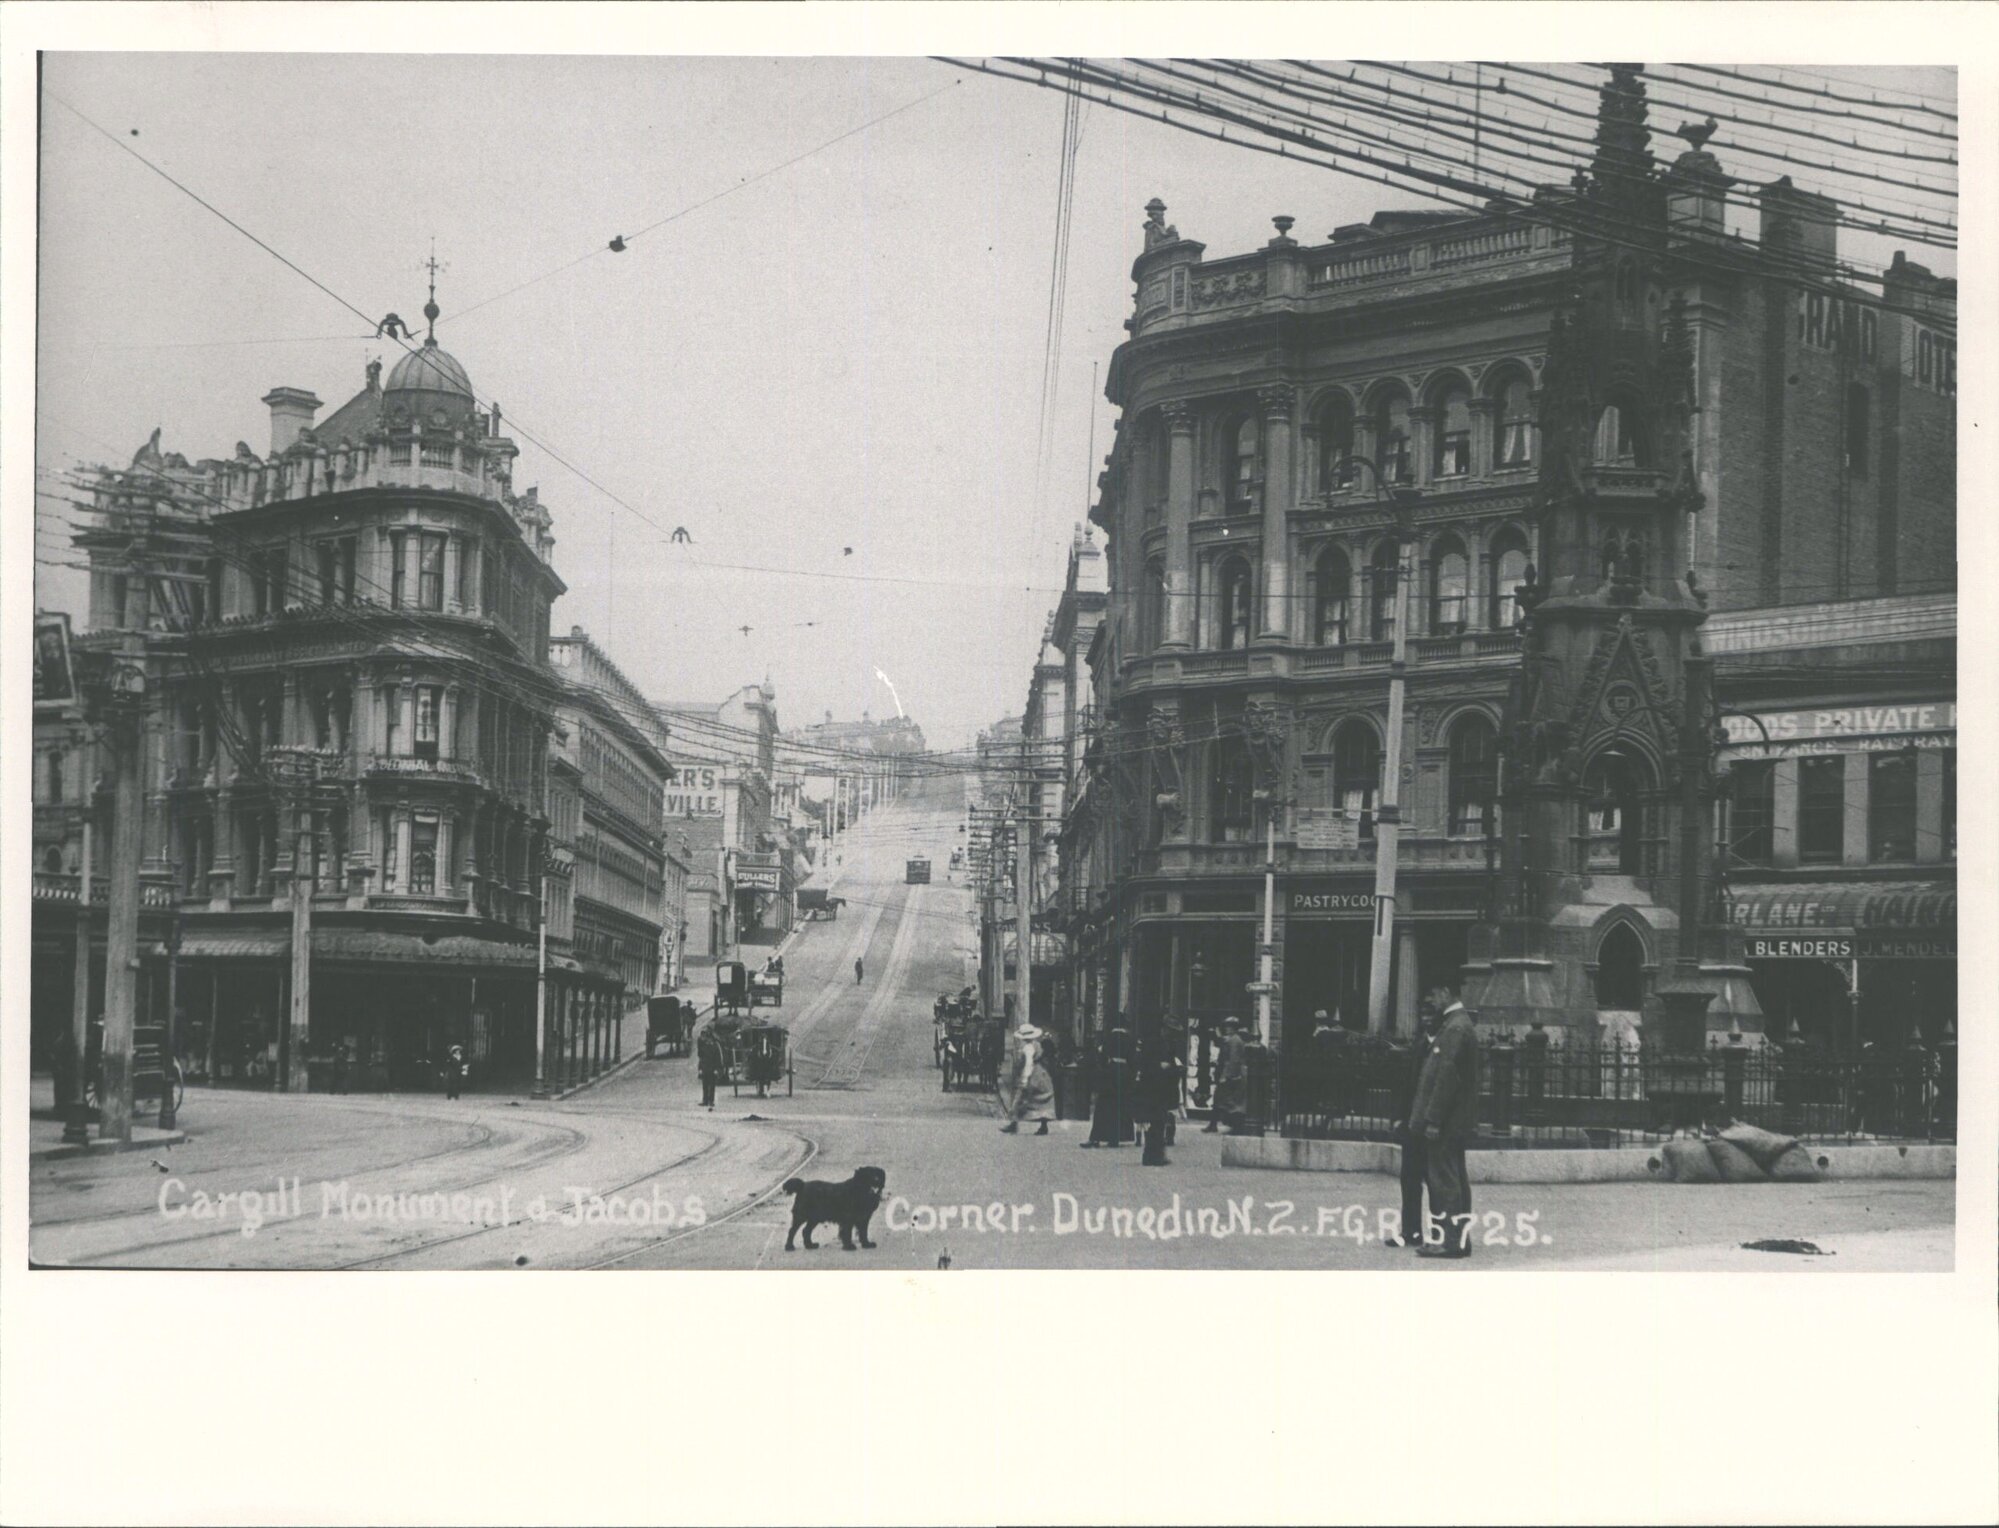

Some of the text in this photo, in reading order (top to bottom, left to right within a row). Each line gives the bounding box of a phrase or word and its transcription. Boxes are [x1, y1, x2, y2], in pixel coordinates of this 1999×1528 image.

[1799, 284, 1878, 366] RAND
[1814, 705, 1936, 737] PRIVATE
[1755, 940, 1851, 957] BLENDERS
